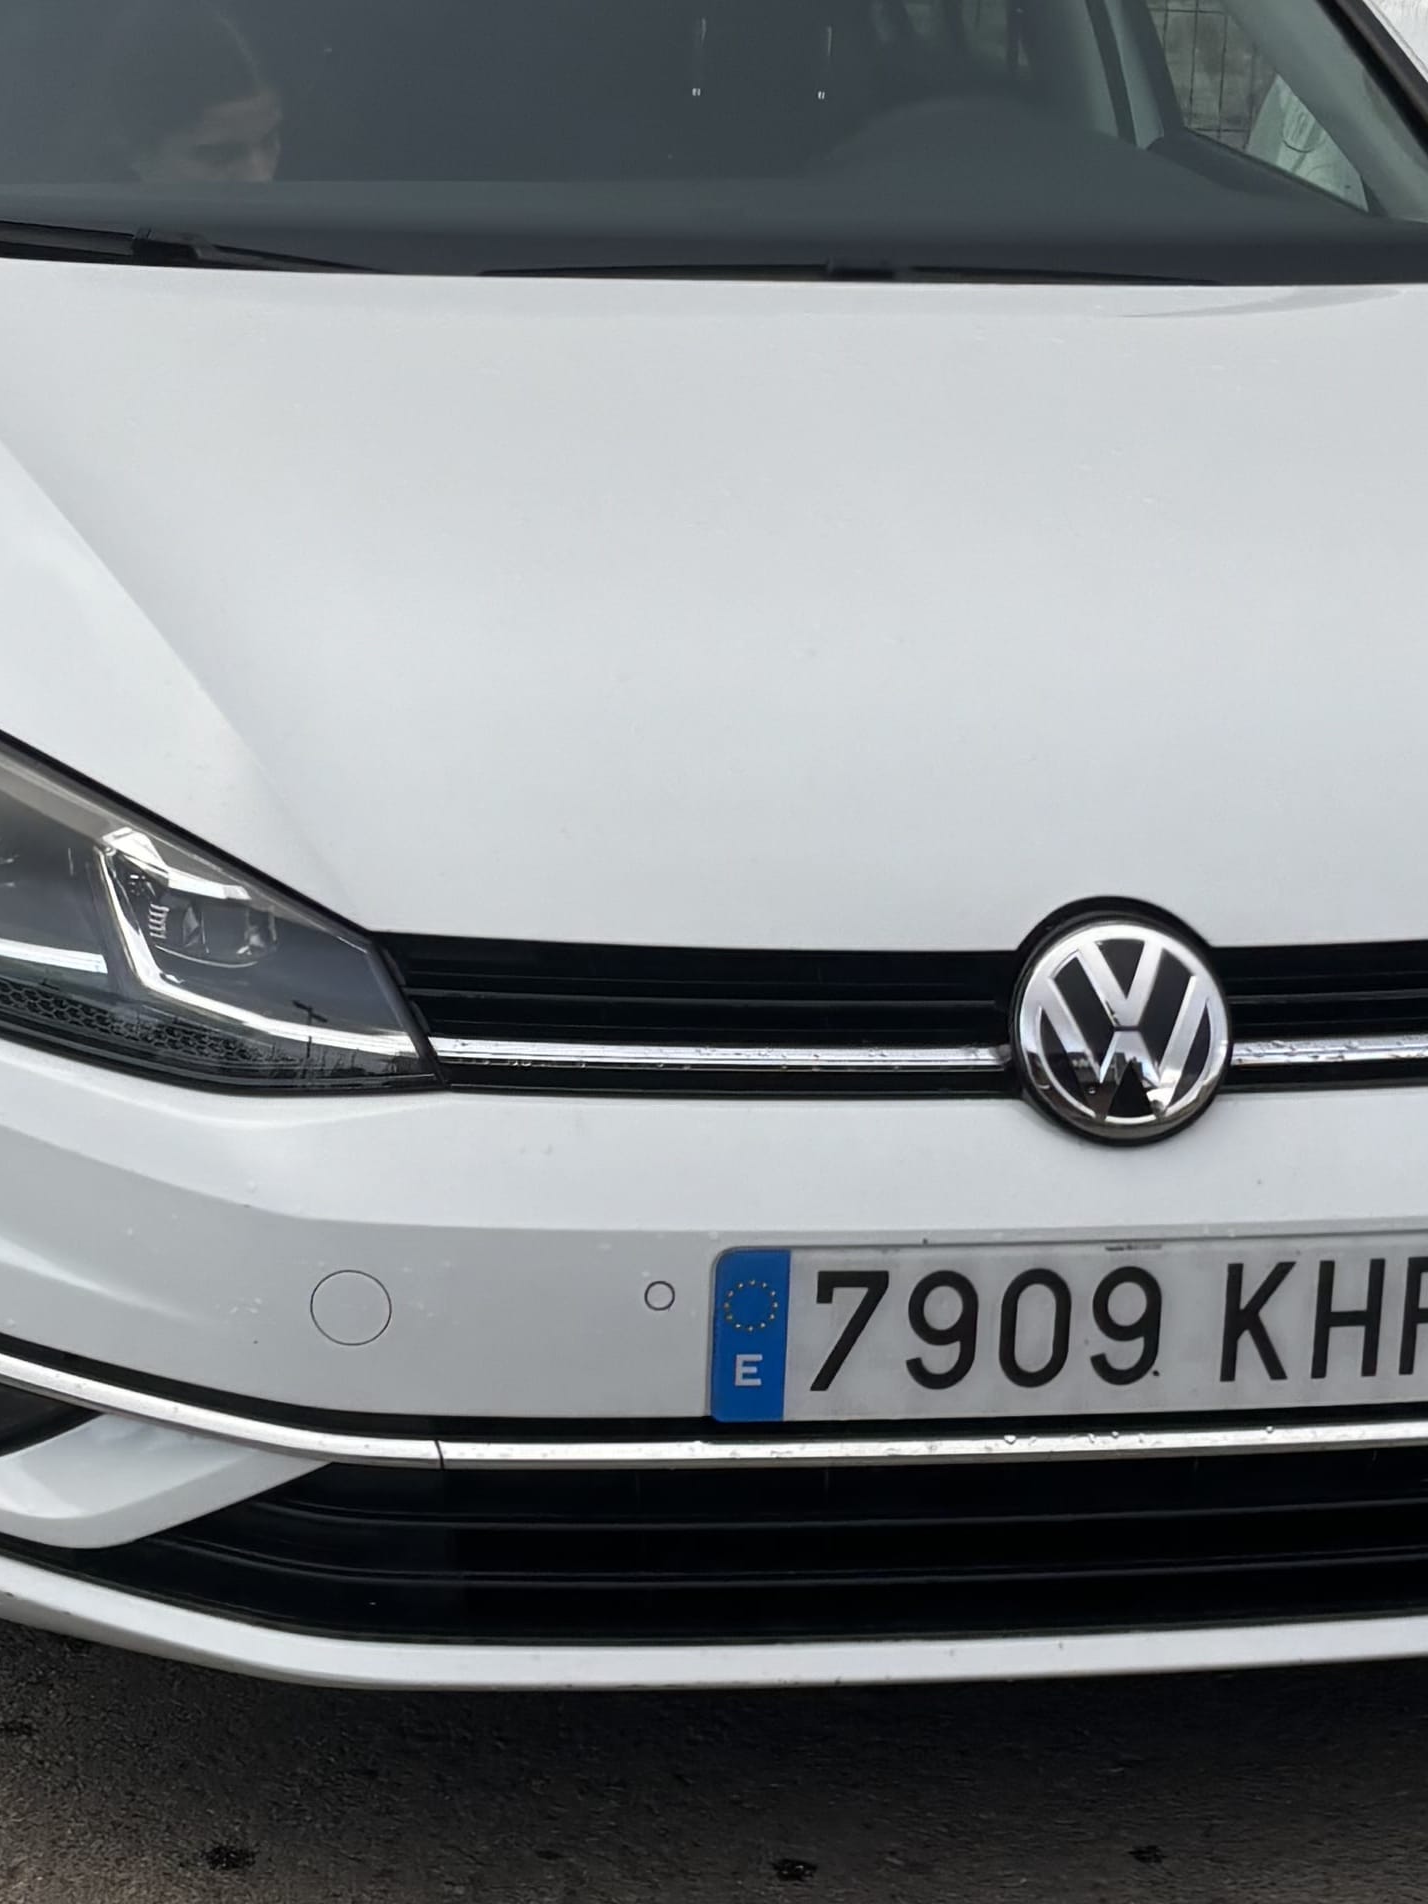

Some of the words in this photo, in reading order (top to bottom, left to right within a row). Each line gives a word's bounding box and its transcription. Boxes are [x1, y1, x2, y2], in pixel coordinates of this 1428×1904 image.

[1027, 928, 1222, 1132] VW
[735, 1354, 763, 1386] E
[810, 1266, 1163, 1393] 7909
